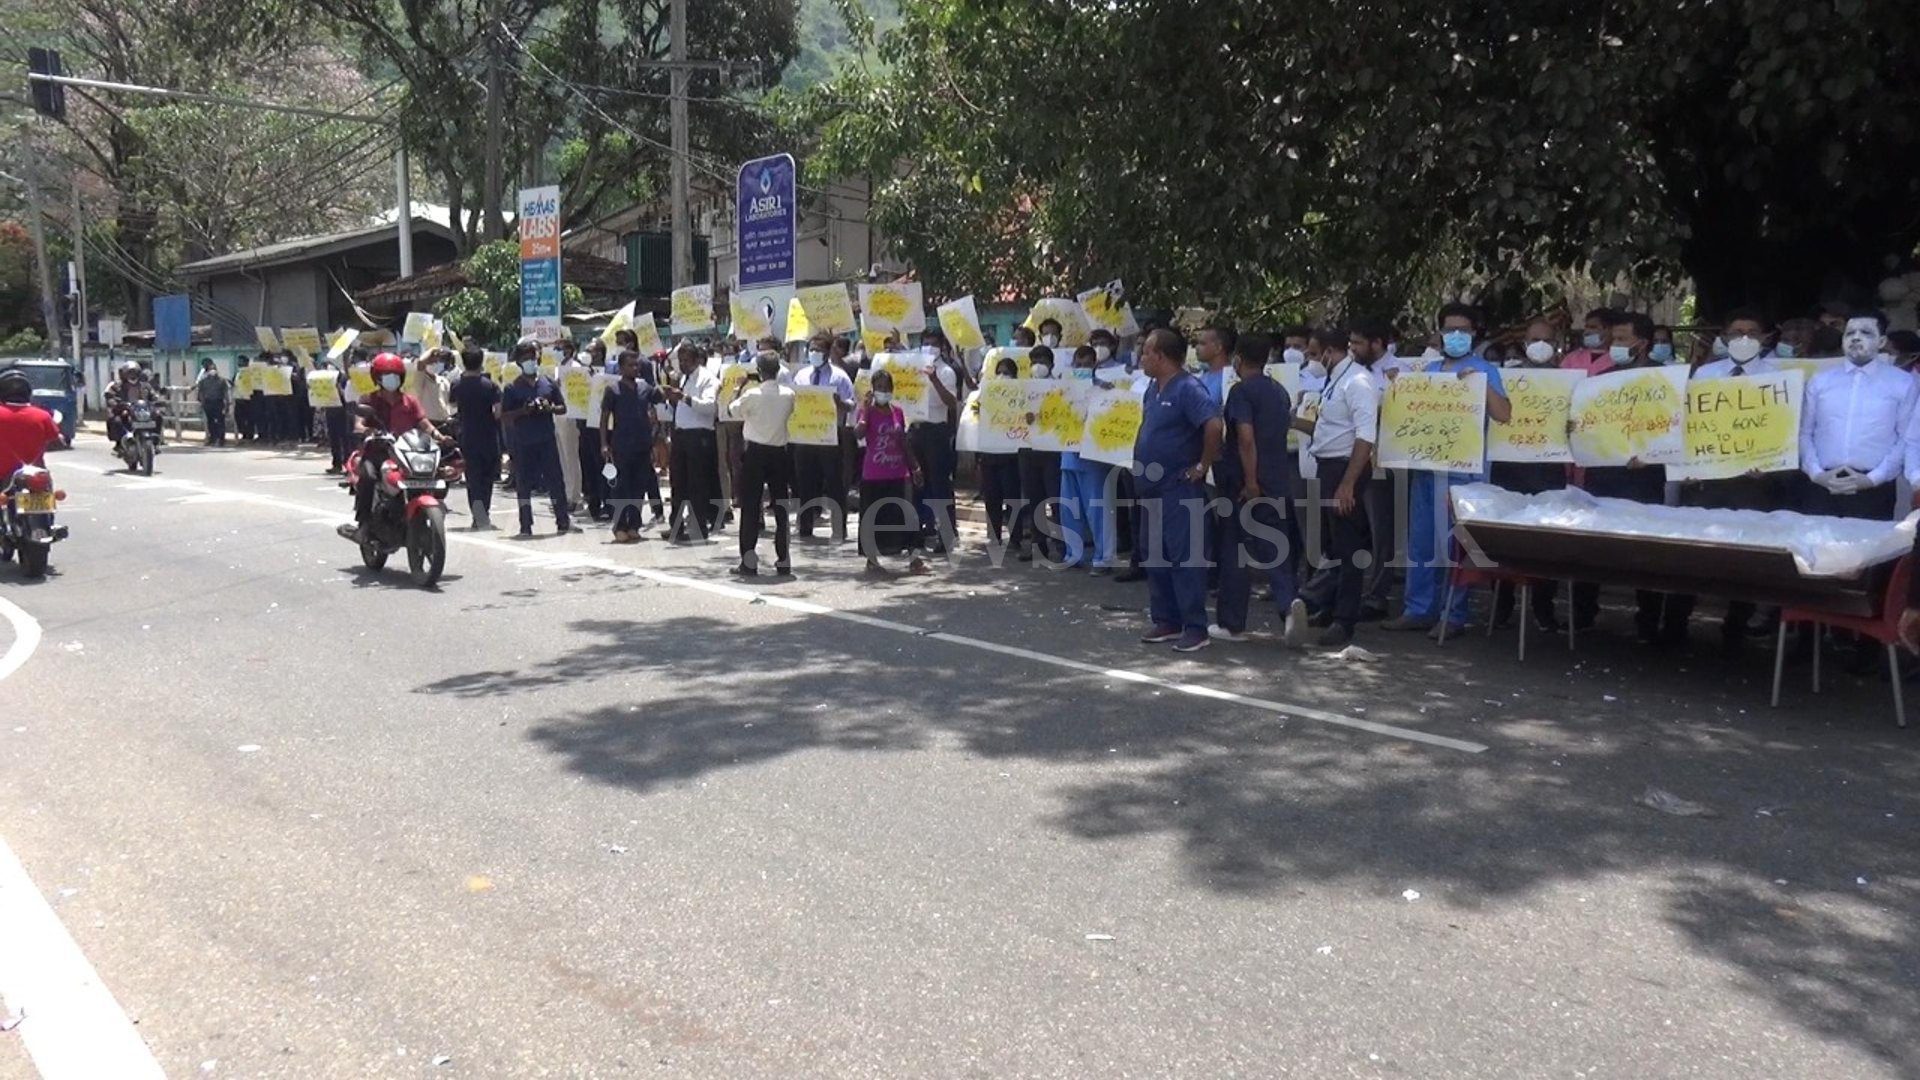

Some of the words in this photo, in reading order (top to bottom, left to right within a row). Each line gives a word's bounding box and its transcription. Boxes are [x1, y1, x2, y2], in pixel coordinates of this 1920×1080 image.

[523, 198, 556, 217] HEMAS
[749, 194, 782, 214] ASIRI
[521, 215, 556, 240] LABS
[1687, 420, 1718, 434] HAS
[1732, 413, 1769, 430] GONE
